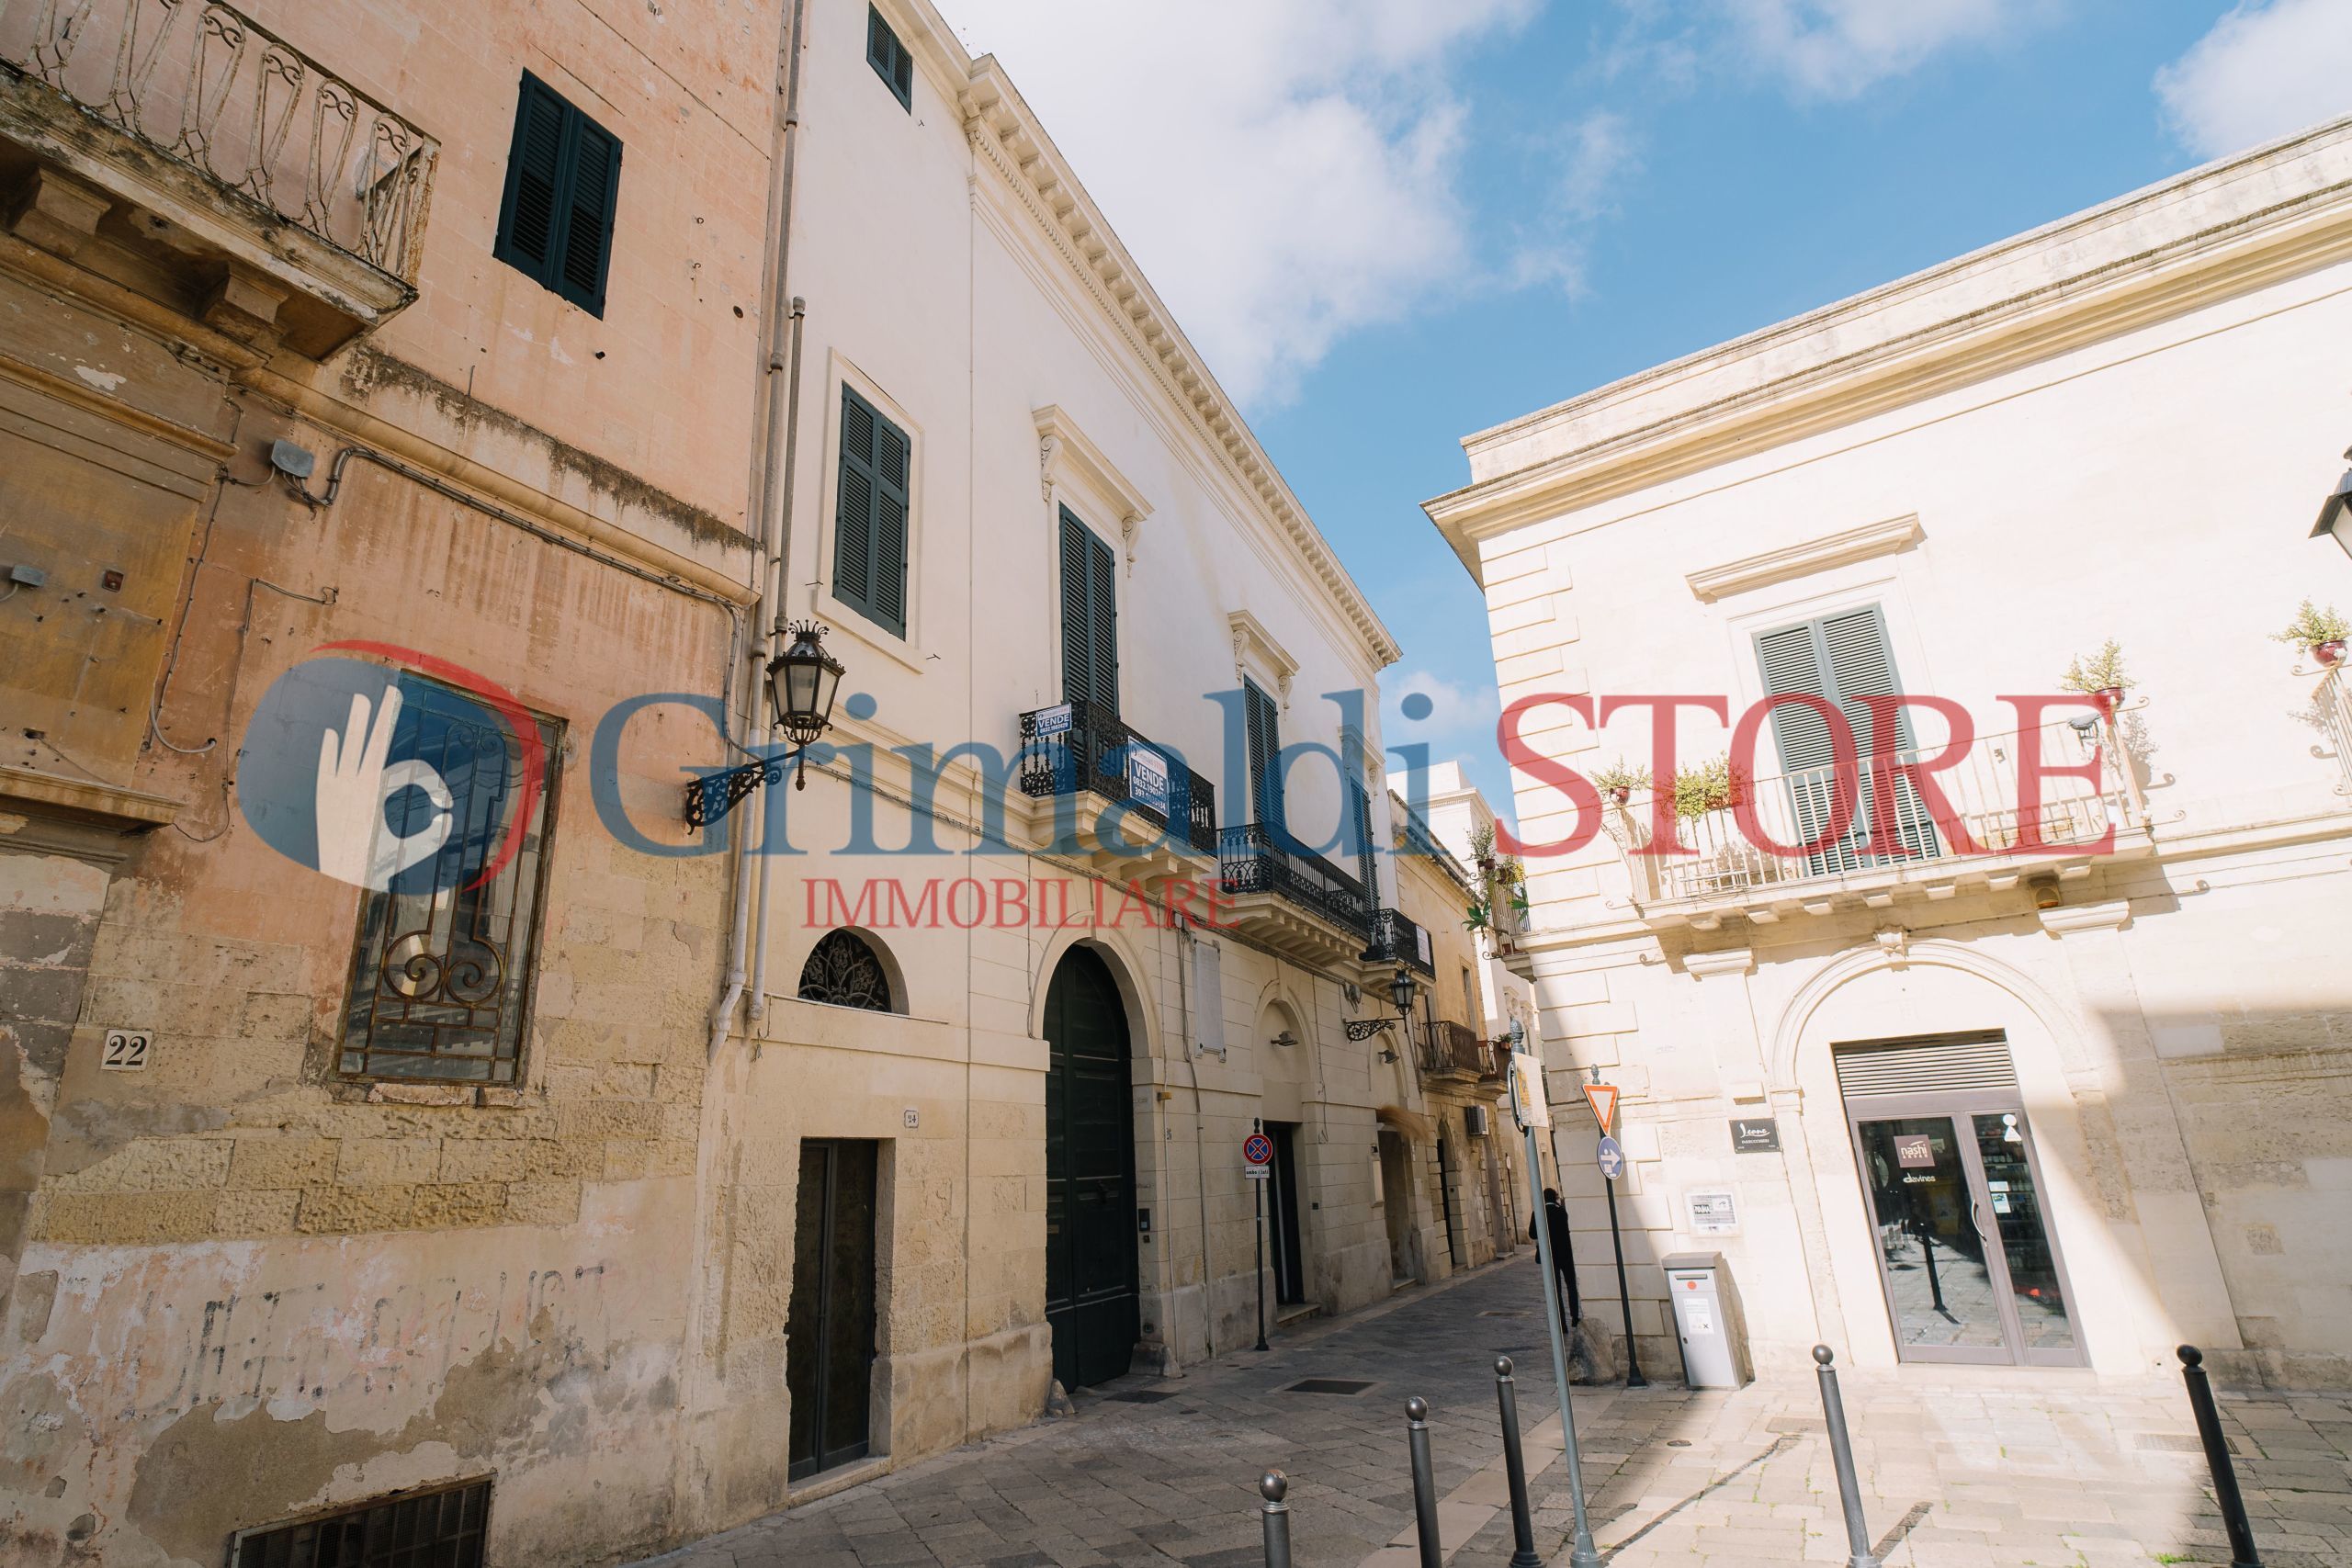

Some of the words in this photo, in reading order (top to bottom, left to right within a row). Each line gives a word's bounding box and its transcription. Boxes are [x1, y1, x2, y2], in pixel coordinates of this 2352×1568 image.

[1038, 714, 1069, 728] VENDE
[1135, 761, 1164, 791] VENDE
[105, 1034, 147, 1066] 22
[1900, 1144, 1928, 1156] nashi
[1903, 1172, 1936, 1184] davines
